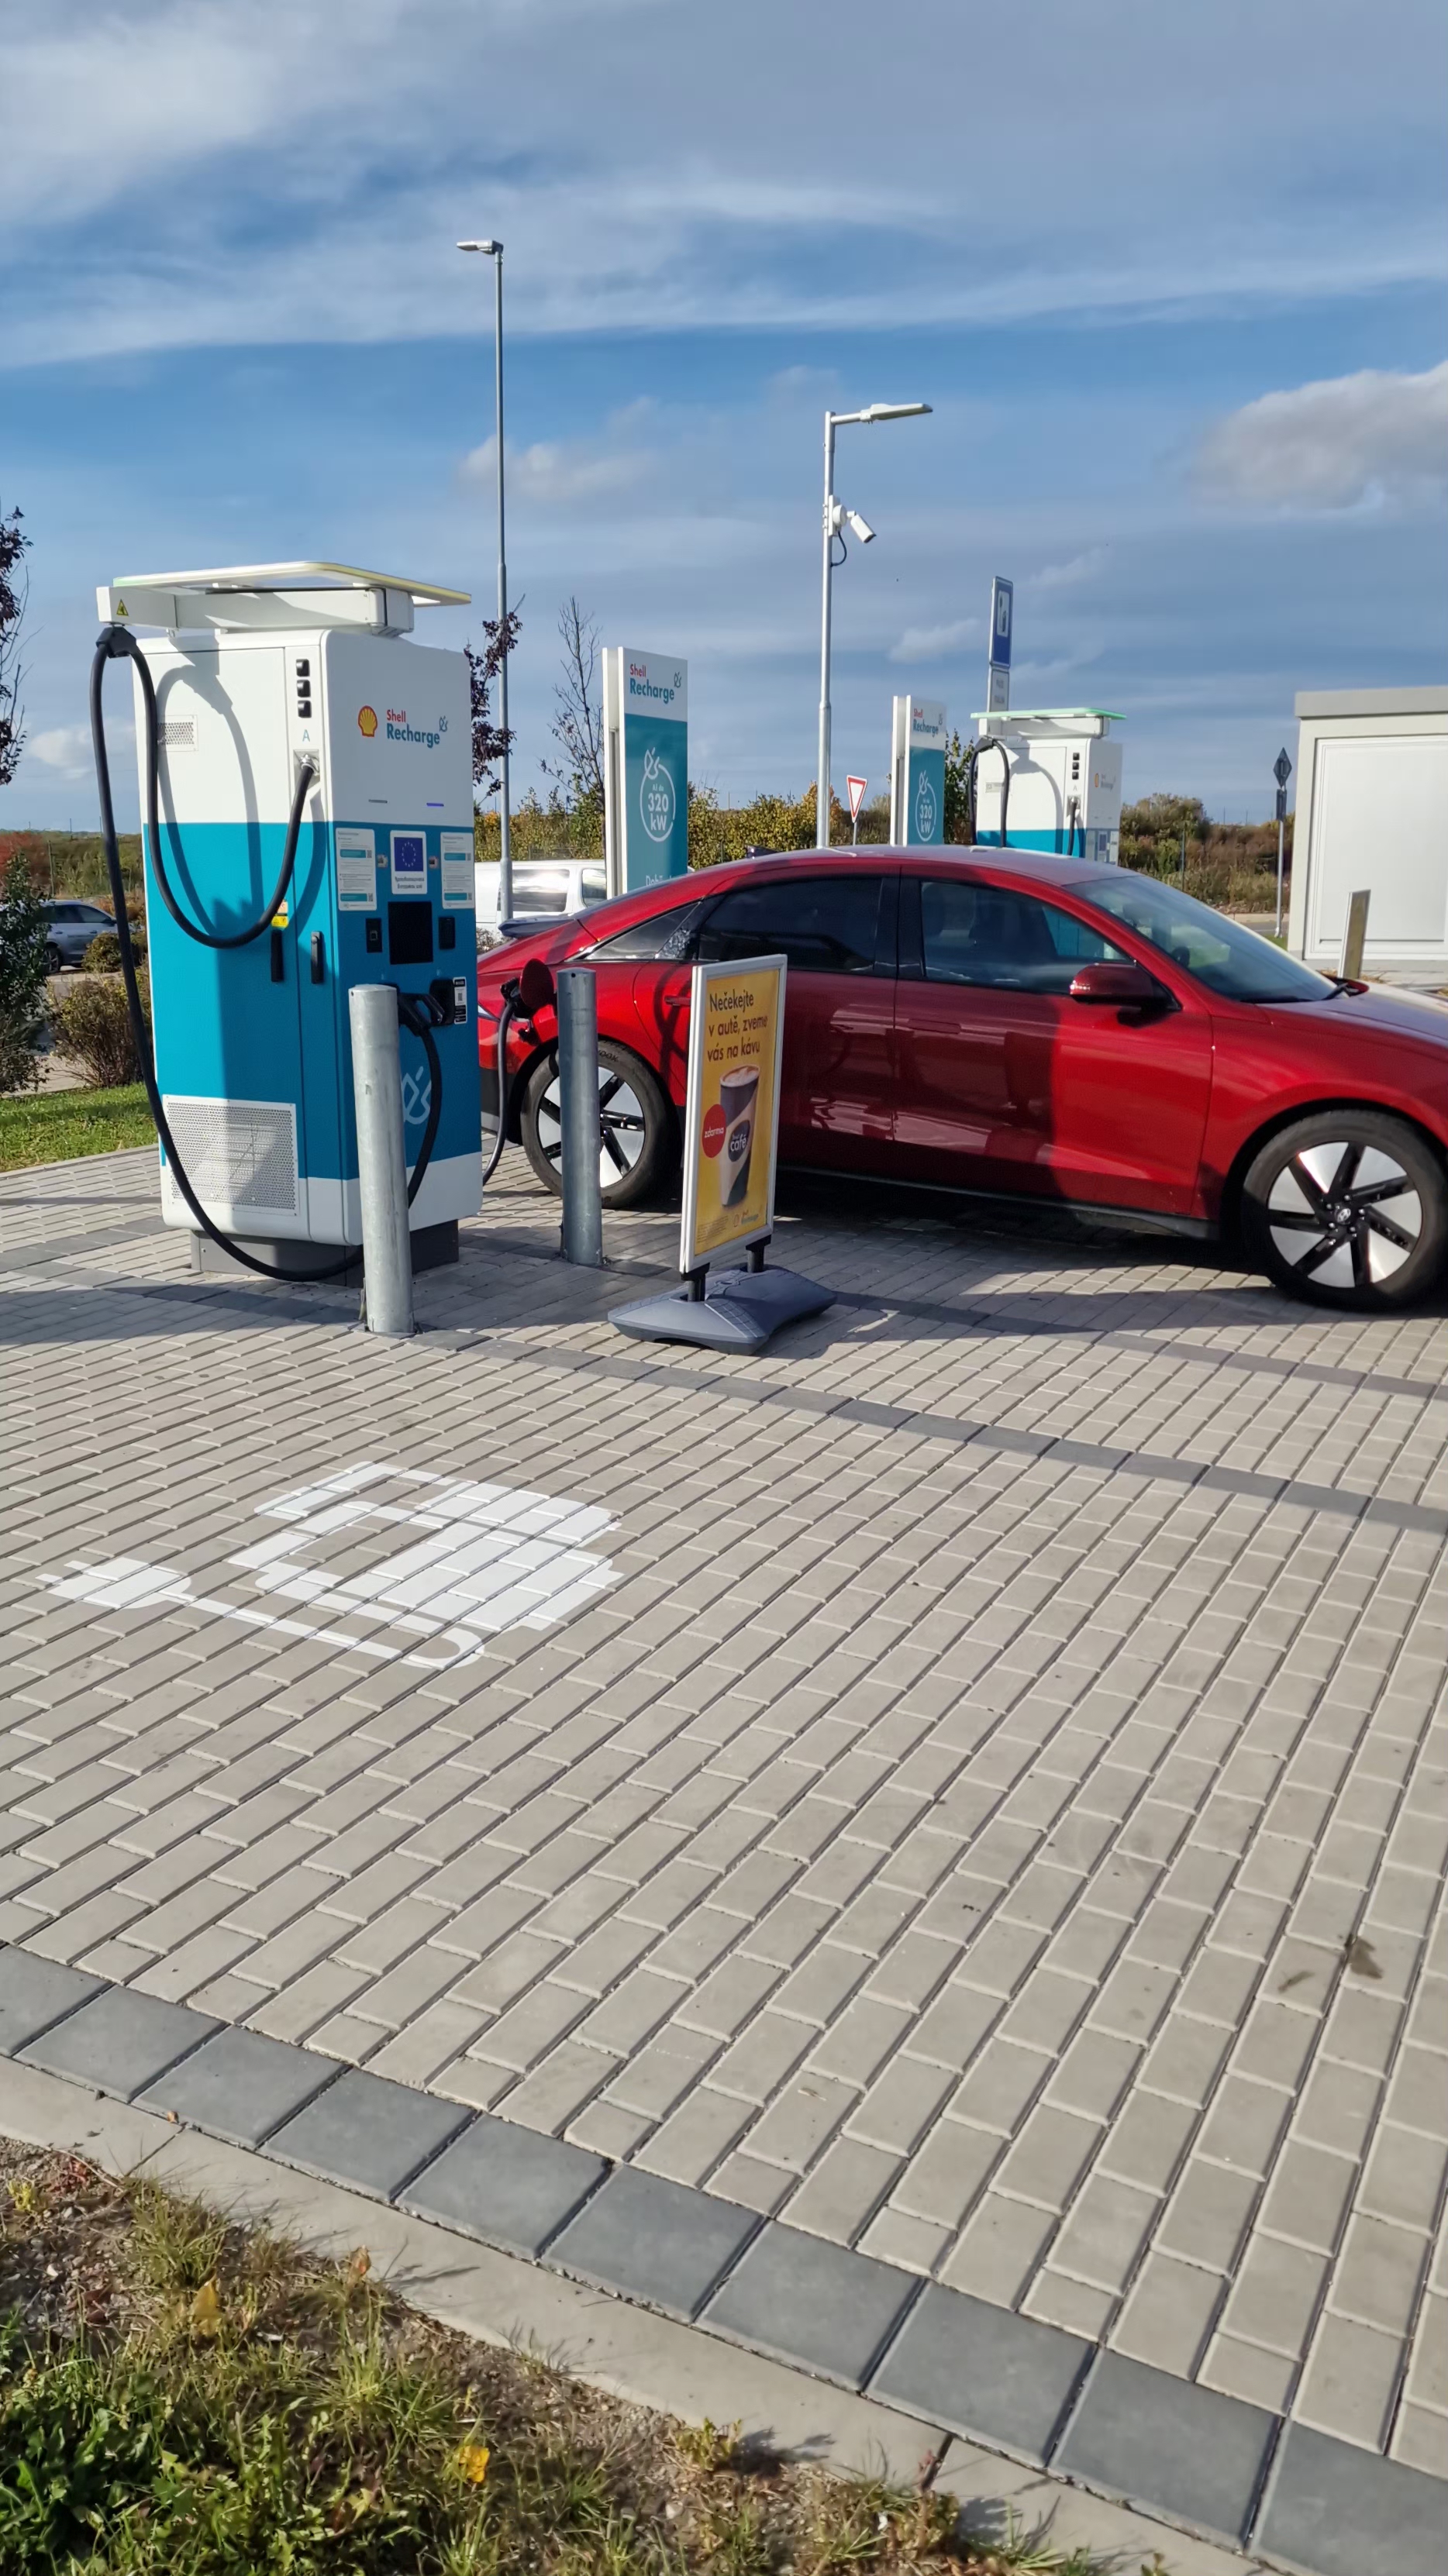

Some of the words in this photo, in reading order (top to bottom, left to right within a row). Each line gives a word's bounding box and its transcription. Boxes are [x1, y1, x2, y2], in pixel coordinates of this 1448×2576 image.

[630, 663, 646, 677] Shell
[629, 677, 674, 704] Recharge
[386, 709, 406, 723] Shell
[302, 728, 311, 742] A
[386, 723, 440, 749] Recharge
[913, 718, 939, 738] Recharge
[647, 793, 669, 813] 320
[919, 804, 933, 819] 320
[650, 813, 667, 831] kW
[920, 820, 931, 834] kW
[710, 988, 754, 1013] Nečekejte
[708, 1025, 715, 1038] v
[718, 1014, 740, 1036] autě,
[743, 1015, 768, 1032] zveme
[707, 1042, 724, 1062] vás
[726, 1045, 739, 1059] na
[740, 1037, 760, 1057] kávu
[704, 1126, 725, 1138] zdarma
[730, 1134, 747, 1152] café
